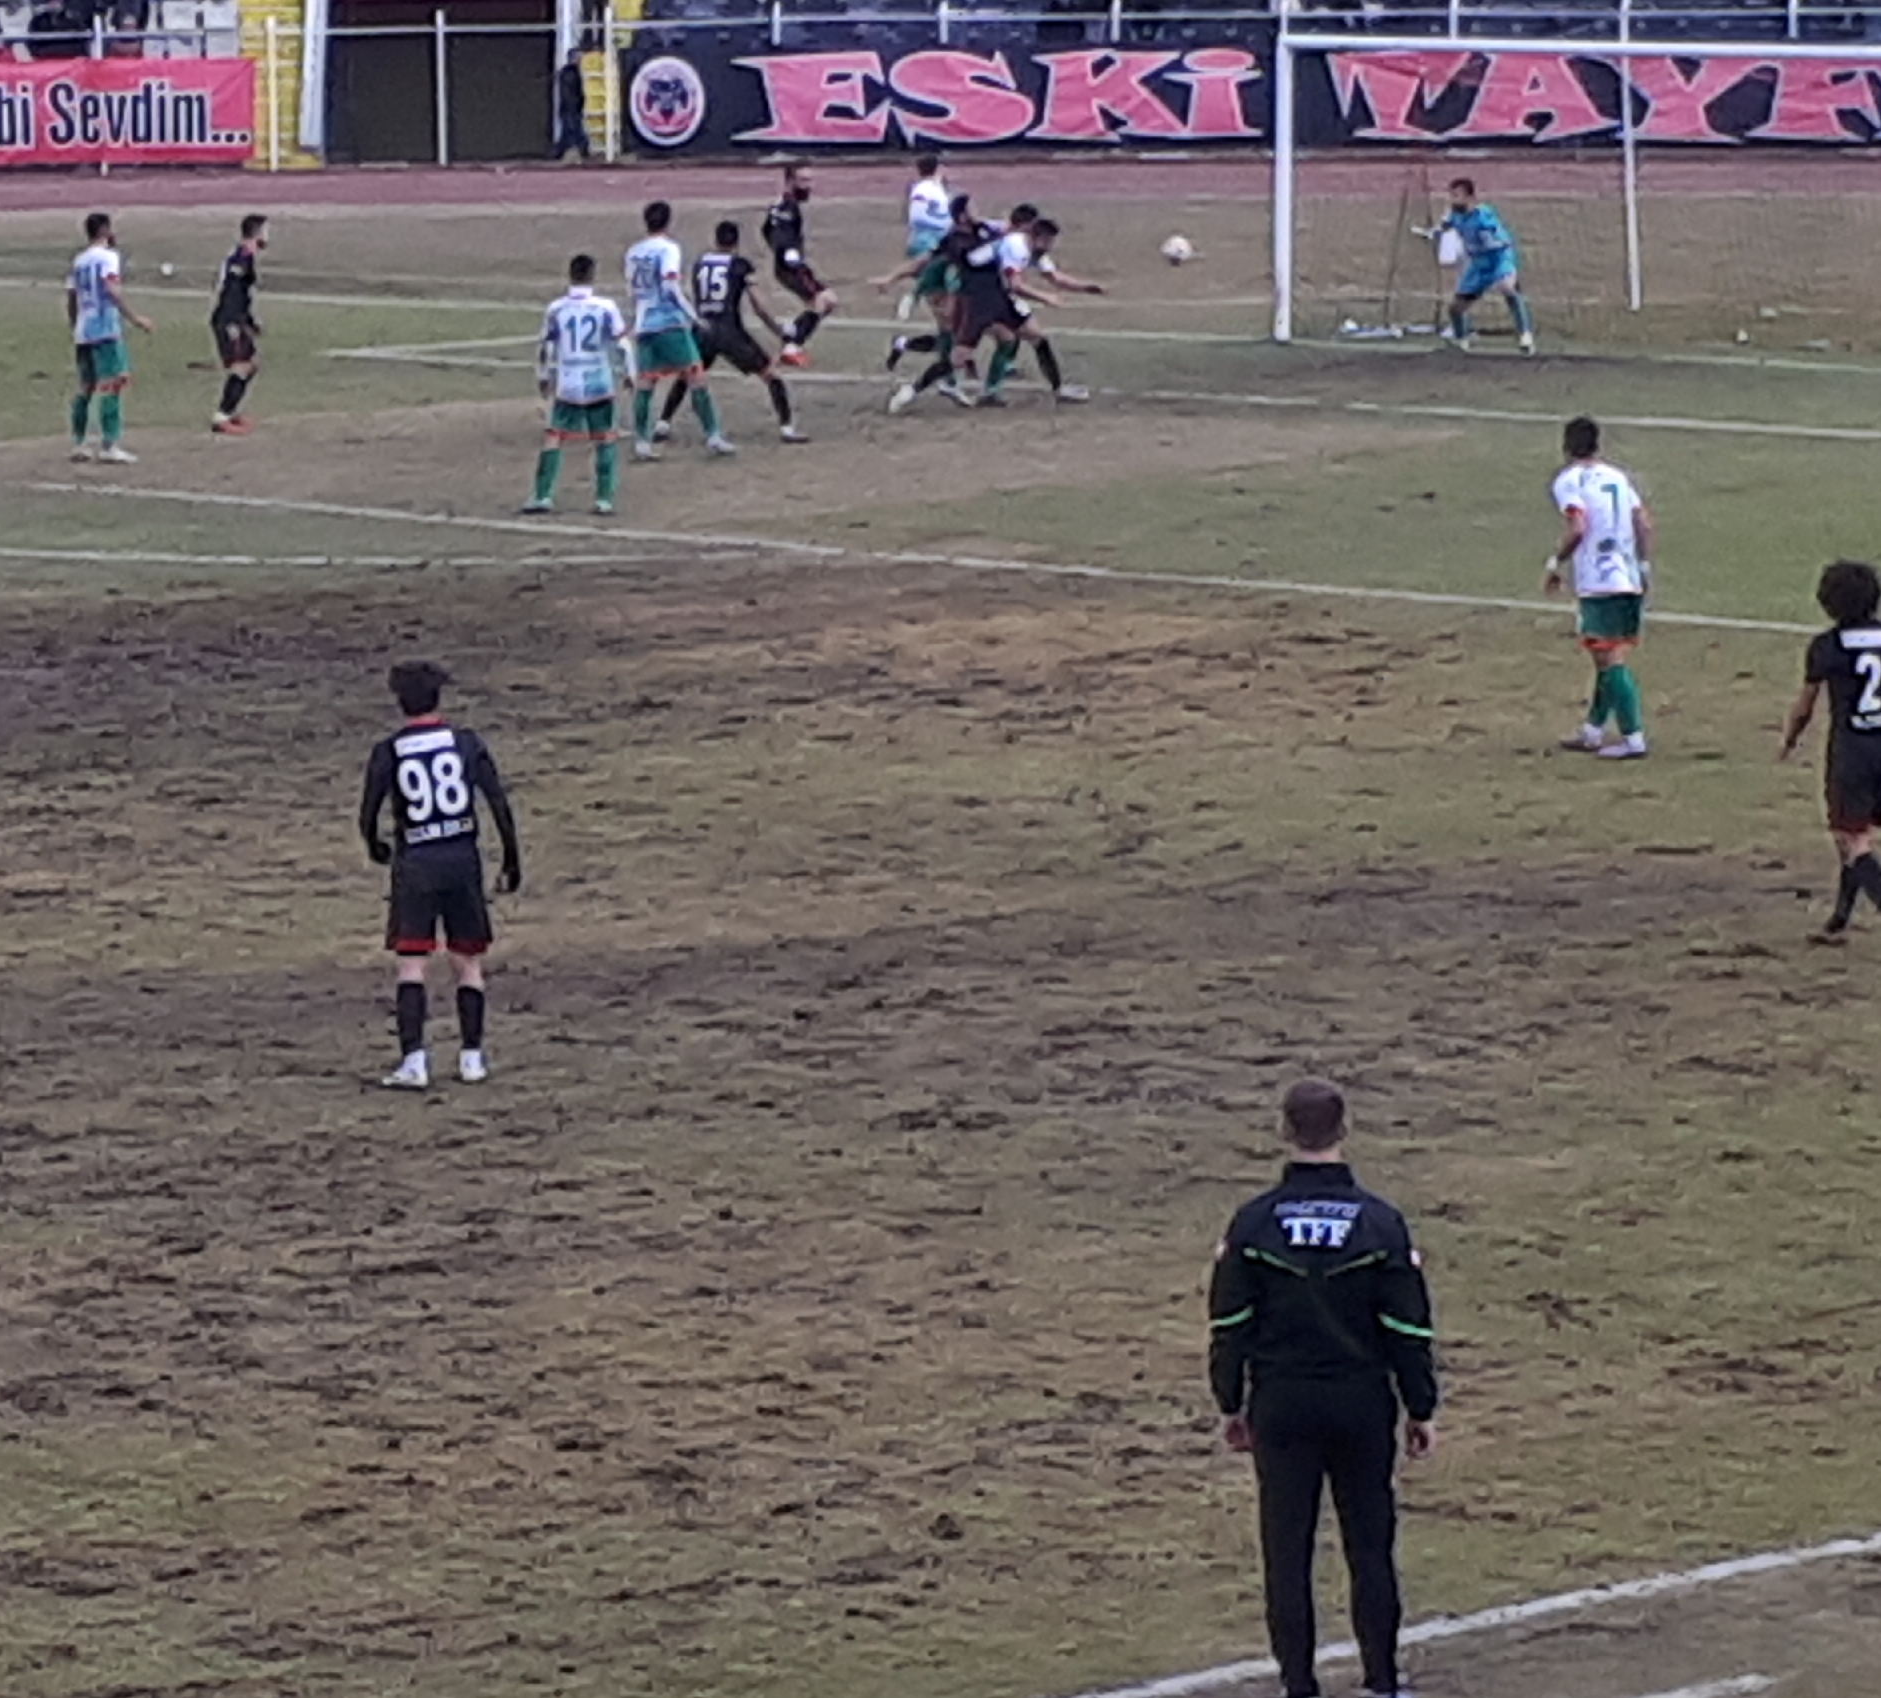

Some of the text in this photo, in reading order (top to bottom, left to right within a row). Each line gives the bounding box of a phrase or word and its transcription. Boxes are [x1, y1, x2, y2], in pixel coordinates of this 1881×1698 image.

[48, 81, 251, 146] Sevdim...
[697, 265, 728, 301] 15
[563, 314, 601, 352] 12
[1599, 483, 1618, 530] 7
[397, 751, 469, 822] 98
[1282, 1216, 1353, 1247] TFF
